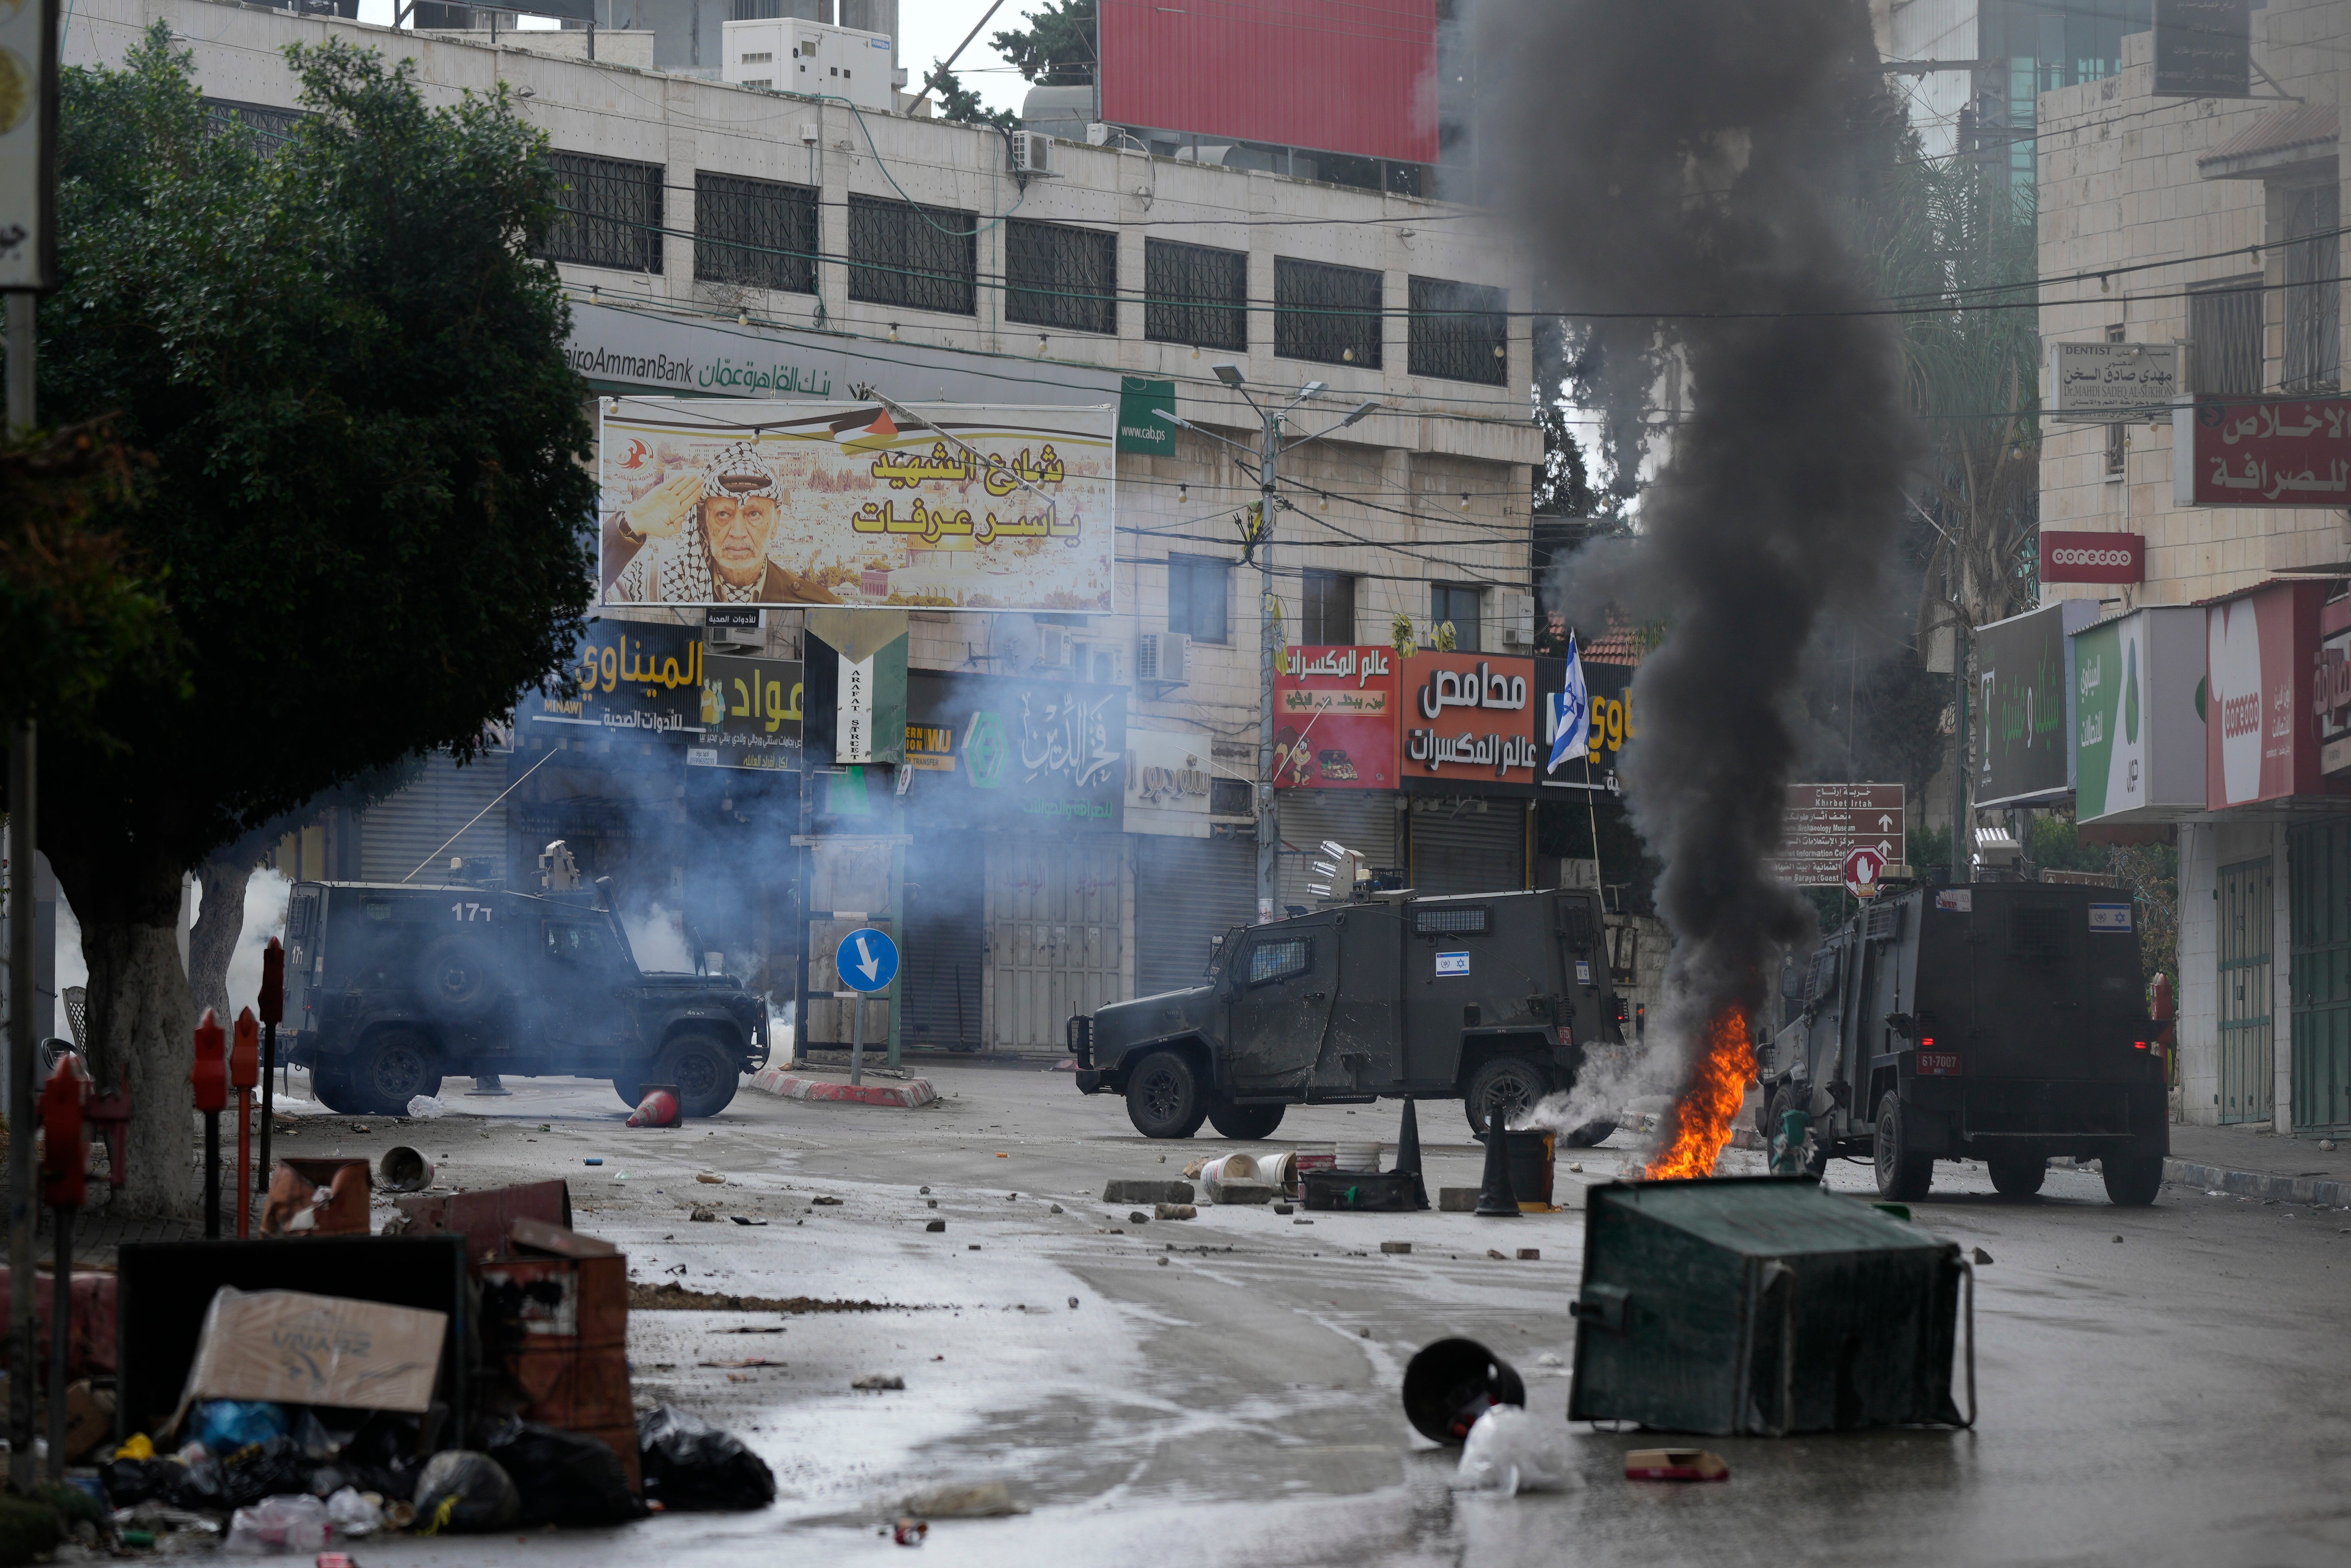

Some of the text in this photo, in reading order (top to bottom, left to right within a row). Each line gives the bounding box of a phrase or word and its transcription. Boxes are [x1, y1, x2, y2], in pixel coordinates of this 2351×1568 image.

[2066, 346, 2112, 355] DENTIST
[798, 369, 831, 400] بنك
[2064, 367, 2172, 387] مهدي صادق السخن
[2102, 386, 2128, 399] SADEQ
[1120, 424, 1166, 443] www.cab.ps
[871, 442, 1064, 497] شارع الشهيد
[2211, 452, 2348, 500] للصرافة
[852, 497, 1081, 548] ياسر عرفات
[2054, 549, 2130, 564] ooredoo
[708, 614, 757, 624] للأدوات الصحية
[576, 635, 704, 702] الميناوي
[1359, 649, 1389, 688] عالم
[2080, 654, 2101, 703] الميناوي
[1420, 661, 1527, 719] محامص
[544, 699, 583, 719] MINAWI
[603, 708, 683, 734] للأدوات الصحية
[850, 670, 861, 760] ARAFAT STREET
[2226, 697, 2258, 733] ooredoo
[2080, 710, 2103, 748] للاتصالات
[1407, 728, 1536, 776] عالم المكسرات
[1816, 786, 1871, 798] خربة إرتاح
[1794, 874, 1816, 883] Saraya
